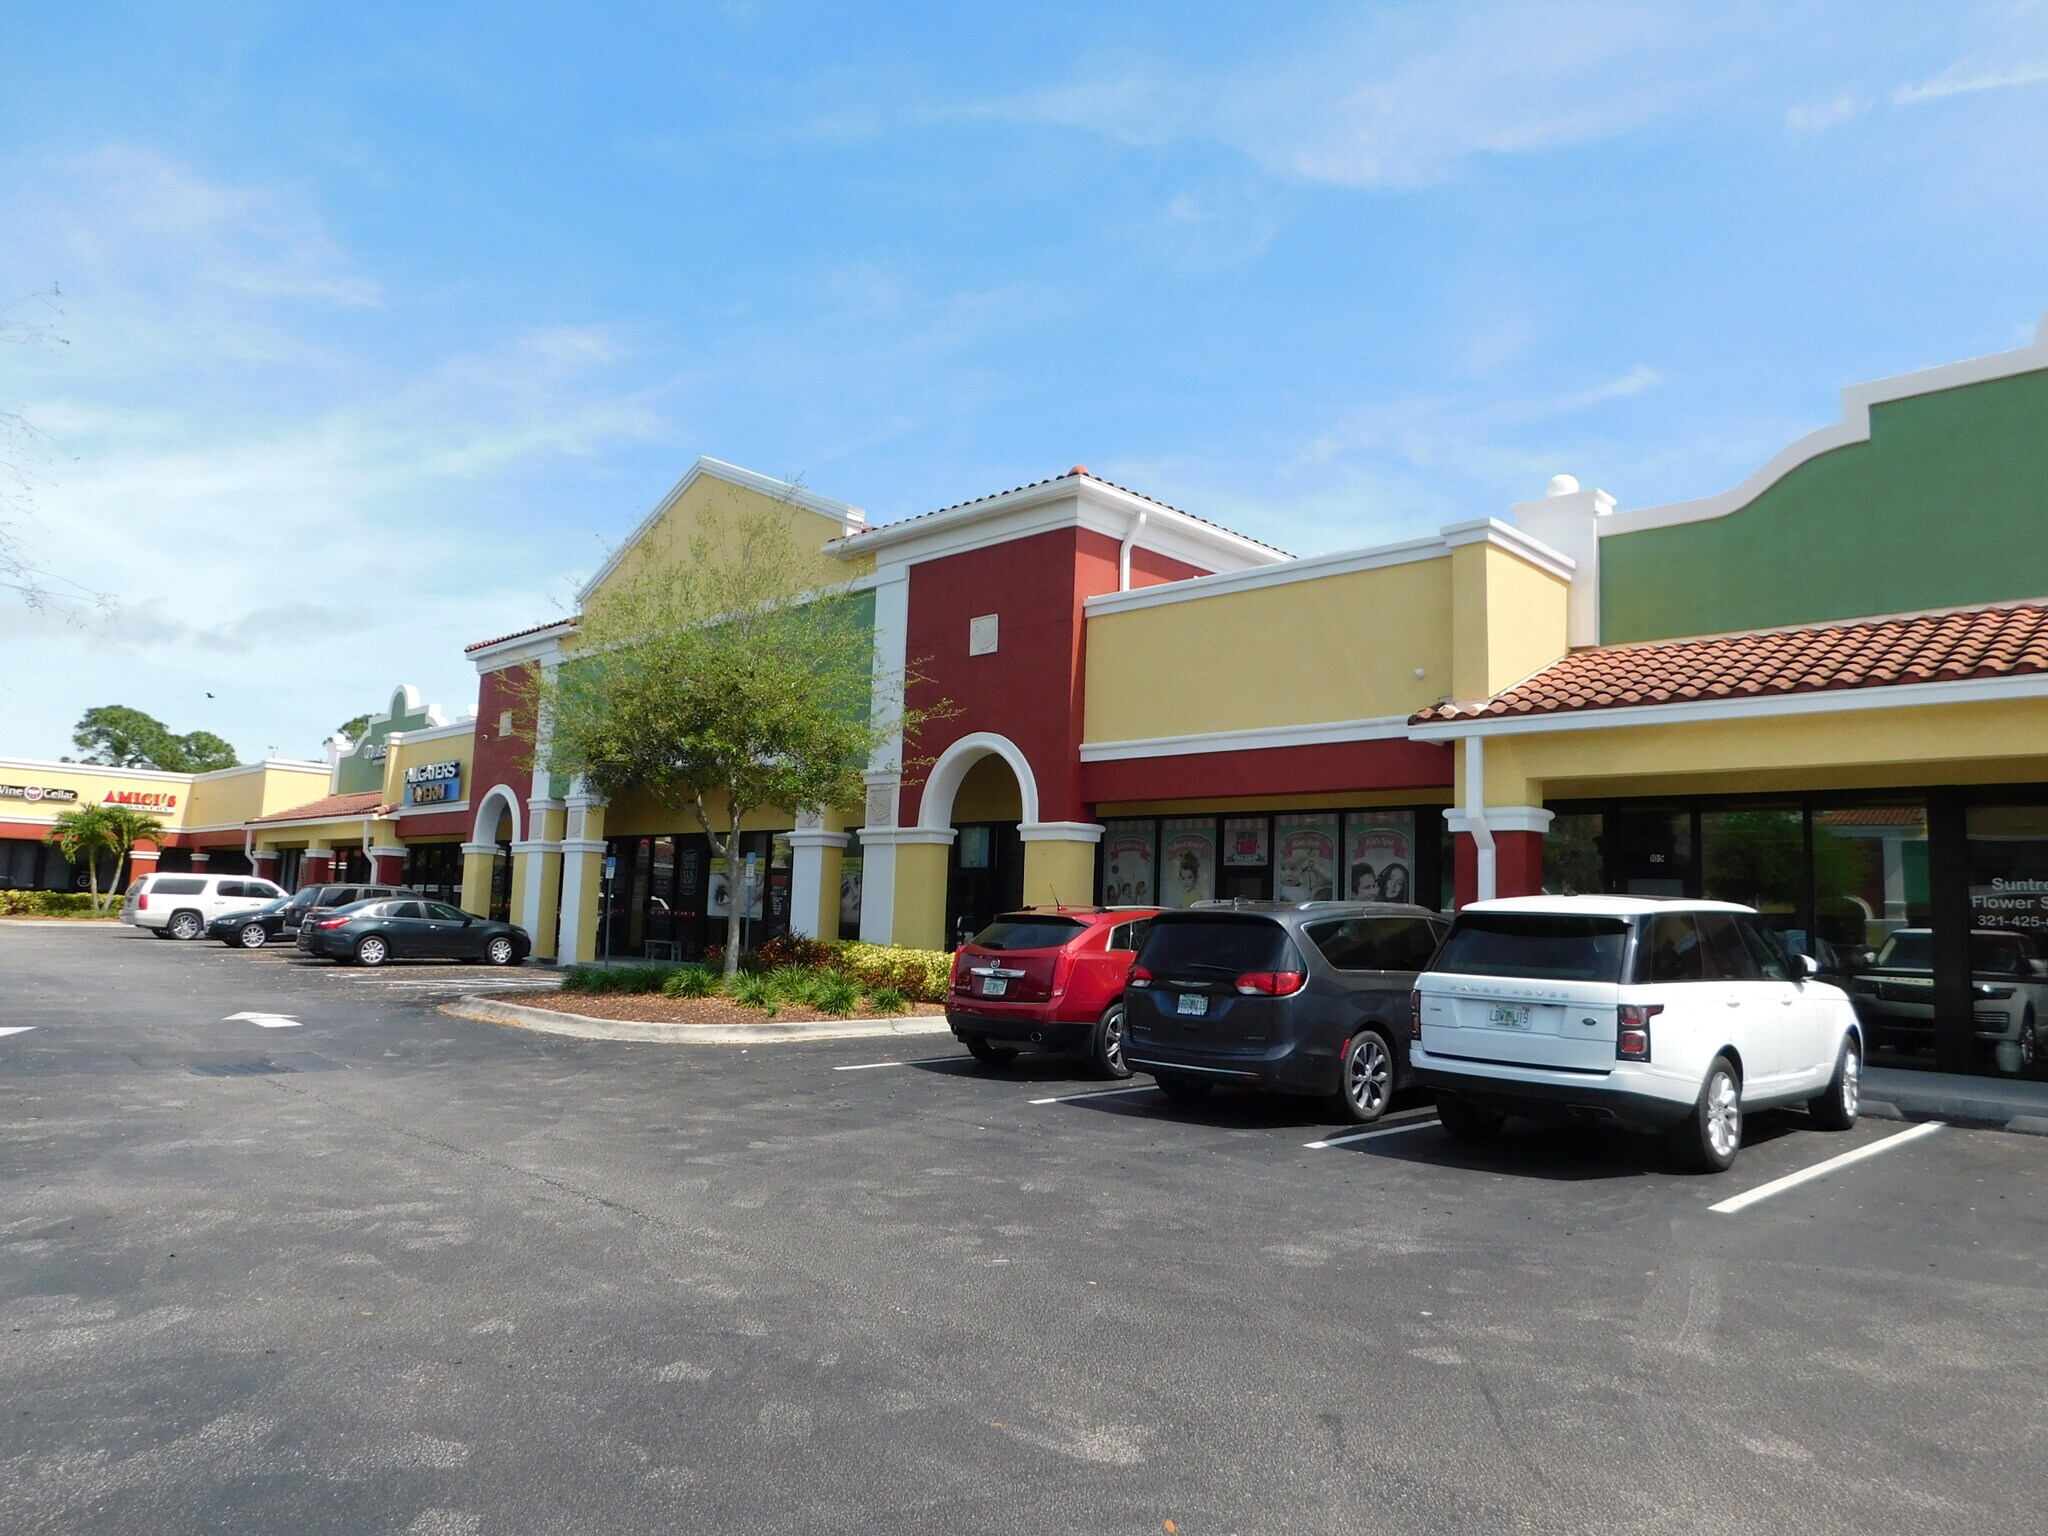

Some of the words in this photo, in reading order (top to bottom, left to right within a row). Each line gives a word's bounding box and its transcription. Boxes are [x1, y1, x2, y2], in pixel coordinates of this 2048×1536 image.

[43, 788, 75, 800] Cellar
[102, 790, 176, 807] AMICI'S
[1971, 895, 2035, 909] Flower
[1977, 915, 2048, 927] 321-425-
[1176, 1008, 1206, 1016] AIRPORT
